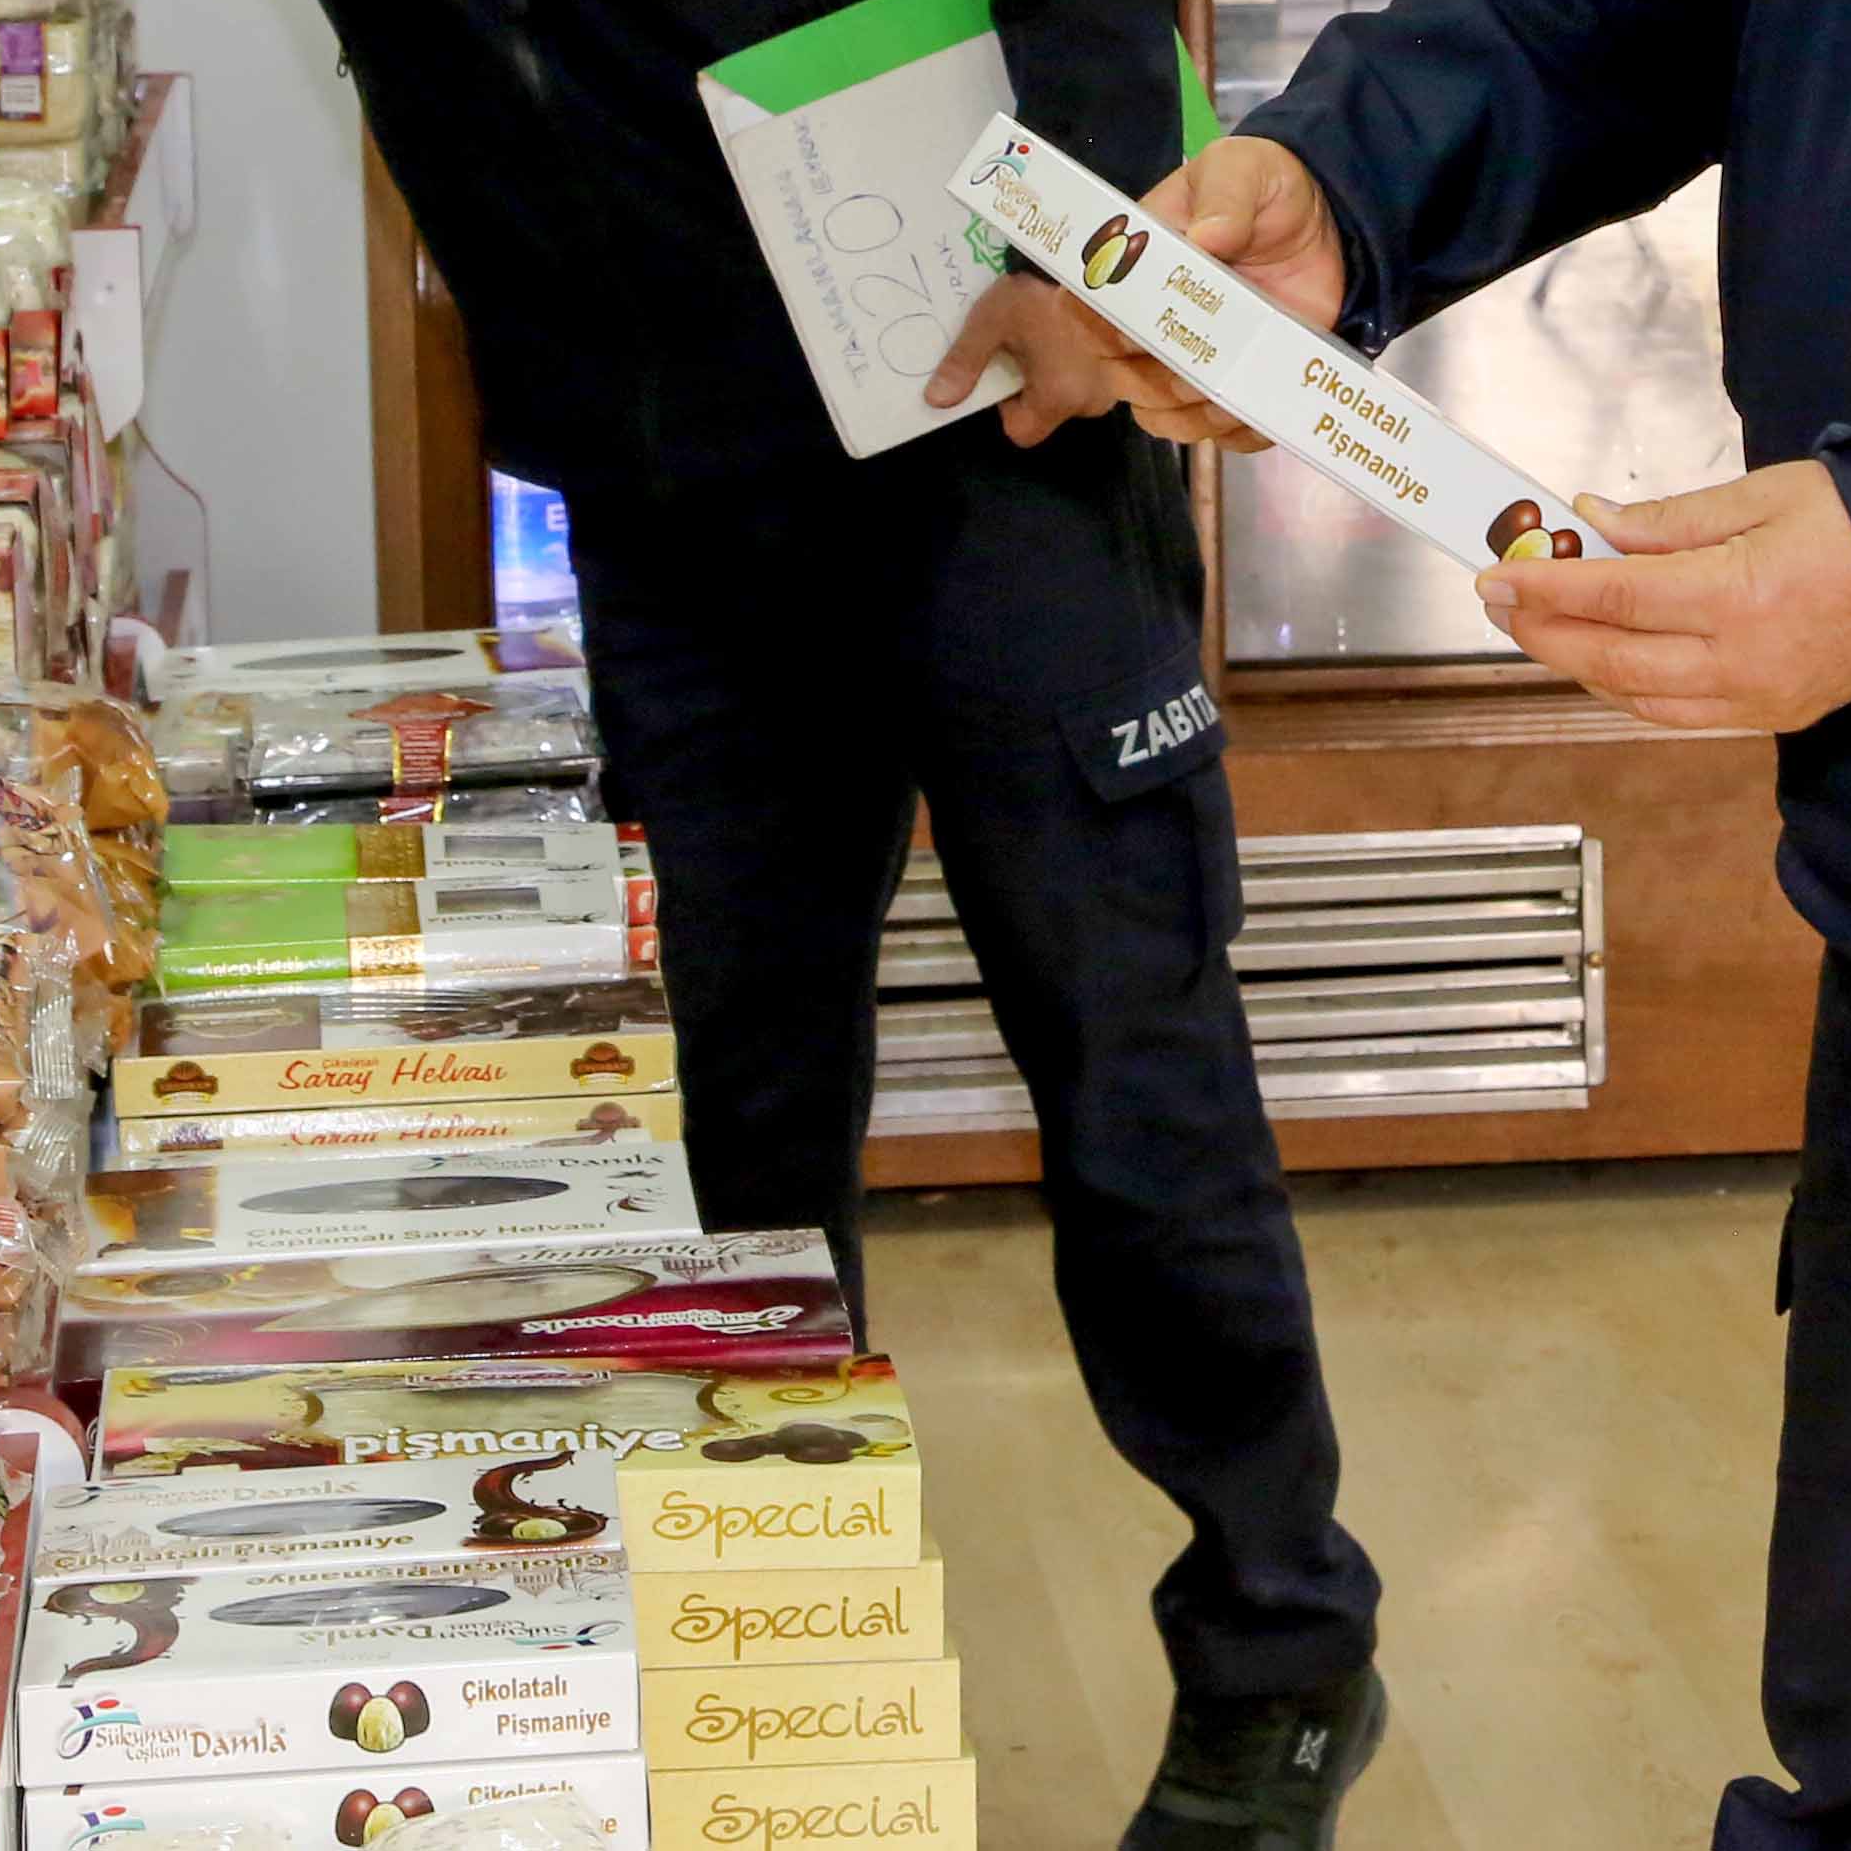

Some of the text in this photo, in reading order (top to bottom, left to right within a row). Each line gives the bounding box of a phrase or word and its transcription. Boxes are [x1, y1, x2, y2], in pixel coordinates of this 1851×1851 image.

[1161, 264, 1225, 317] Çikolatalı
[1155, 306, 1218, 365] Pişmaniye
[1299, 356, 1412, 445] Çikolatalı
[1313, 411, 1430, 506] Pişmaniye
[278, 1052, 508, 1094] Saray Helvası
[403, 1227, 487, 1241] Saray
[498, 1222, 606, 1235] Helvası
[343, 1427, 686, 1466] pişmaniye
[232, 1480, 359, 1501] Damla
[651, 1486, 893, 1559] Special
[54, 1533, 414, 1570] Çikolatalı Pişmaniye
[298, 1623, 433, 1646] Damla
[670, 1585, 910, 1661] Special
[461, 1674, 568, 1710] Çikolatalı
[190, 1717, 288, 1759] Damla
[496, 1708, 612, 1744] Pişmaniye
[685, 1685, 924, 1761] Special
[701, 1784, 940, 1851] Special
